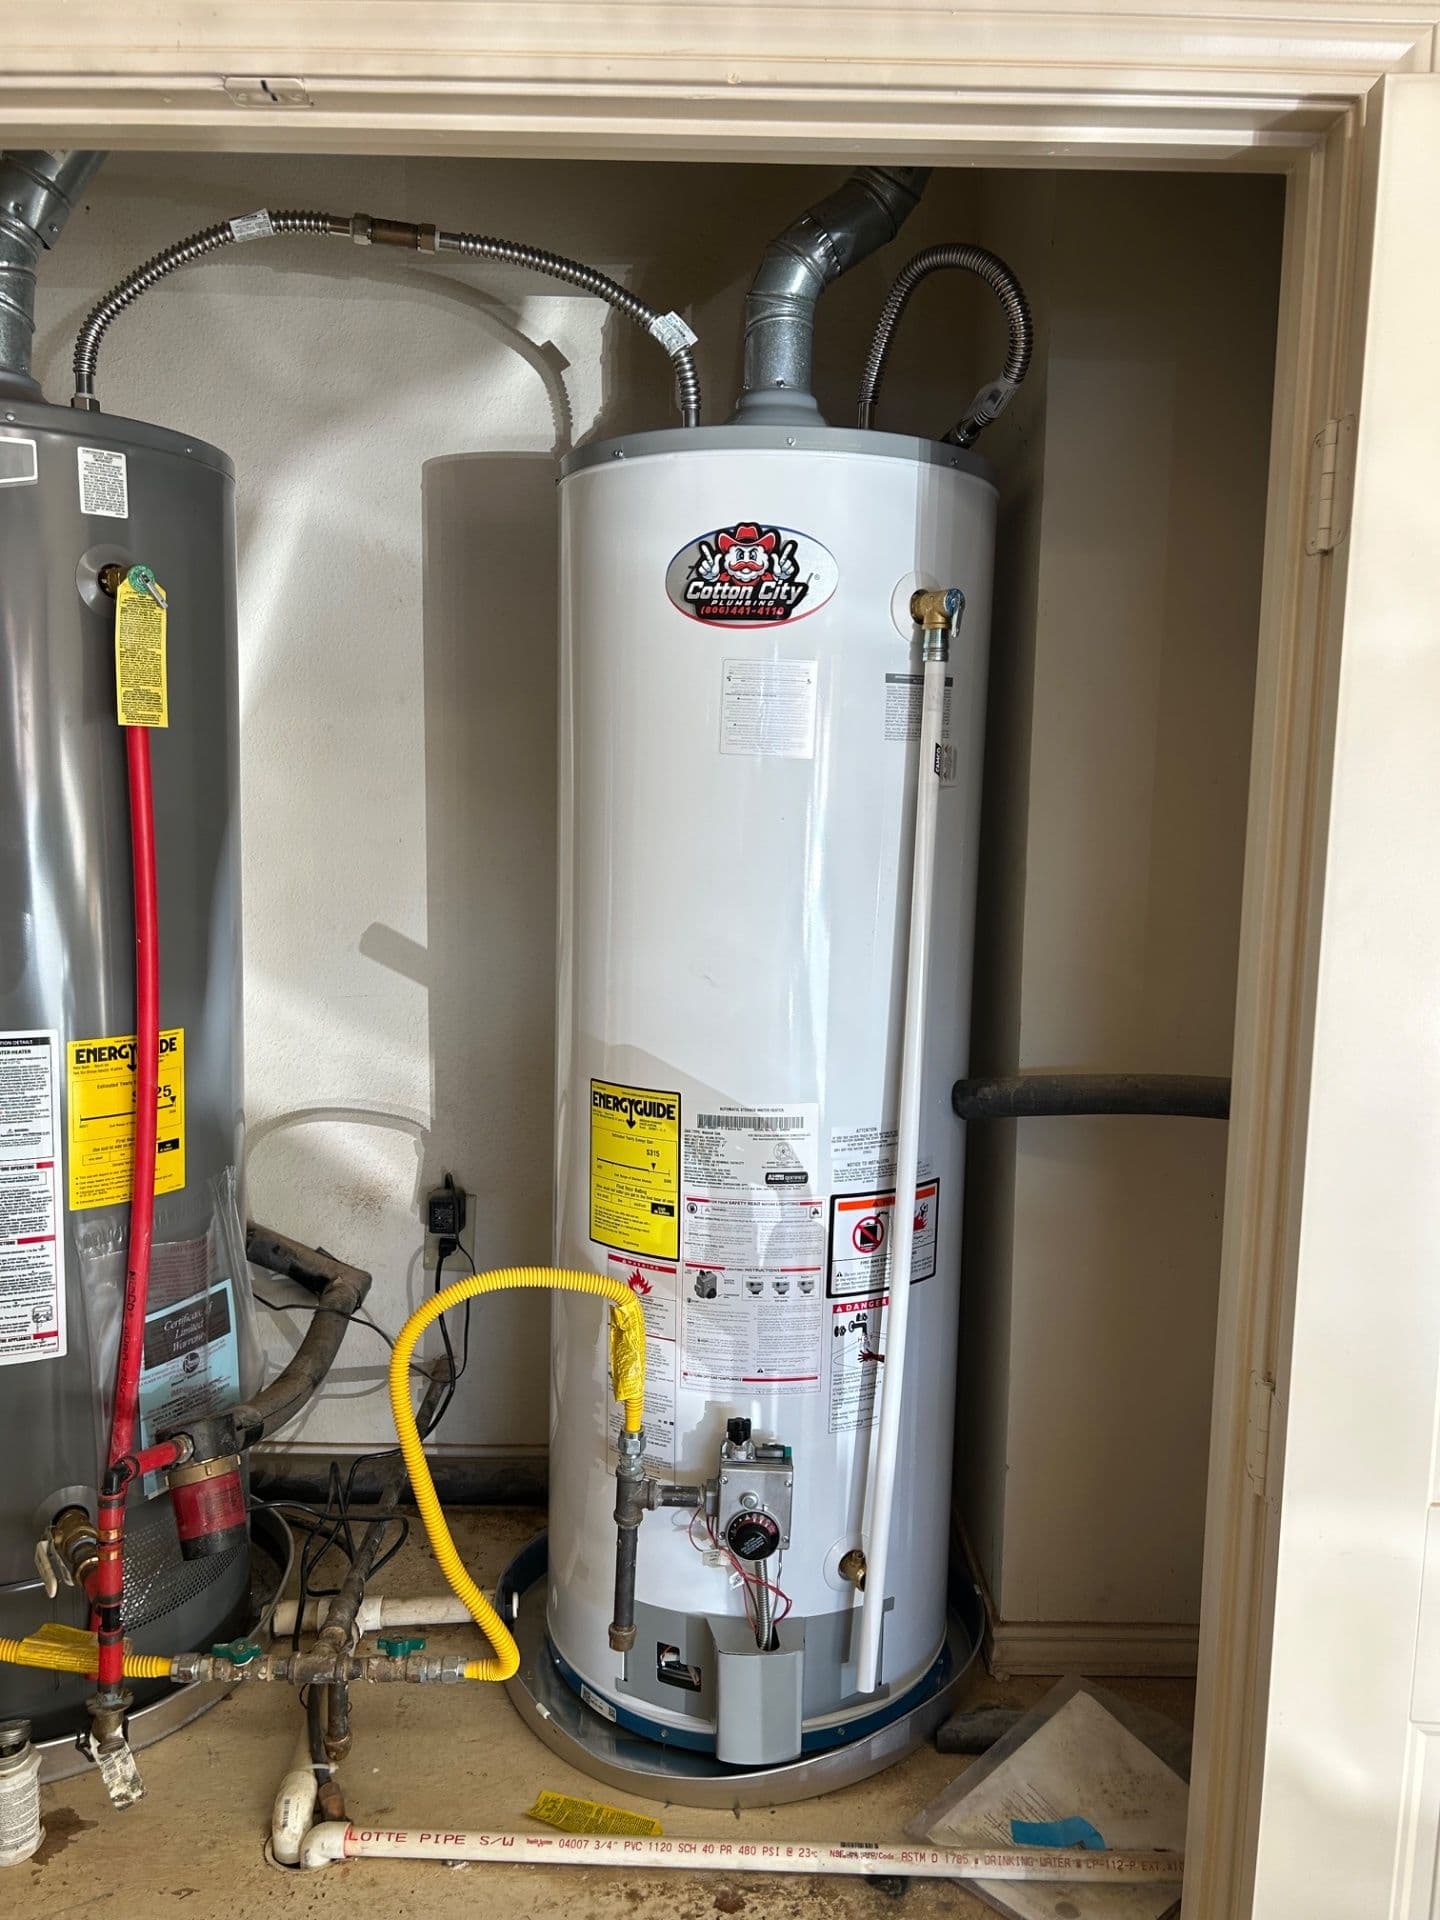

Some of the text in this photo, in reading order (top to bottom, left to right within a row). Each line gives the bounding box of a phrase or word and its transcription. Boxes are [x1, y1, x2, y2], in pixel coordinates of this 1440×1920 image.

[687, 579, 803, 605] Cotton City
[700, 606, 785, 615] (806)441-4110
[592, 1090, 676, 1121] ENERGYGUIDE
[845, 1298, 887, 1311] DANGER
[419, 1834, 466, 1845] PIPE
[479, 1836, 514, 1847] S/W
[558, 1838, 589, 1849] 04007
[623, 1841, 642, 1852] PVC
[648, 1842, 672, 1853] 1120
[678, 1842, 697, 1853] SCH
[702, 1844, 715, 1854] 40
[719, 1844, 733, 1855] PR
[762, 1846, 780, 1857] PSI
[901, 1852, 926, 1863] ASTM
[931, 1853, 938, 1863] D
